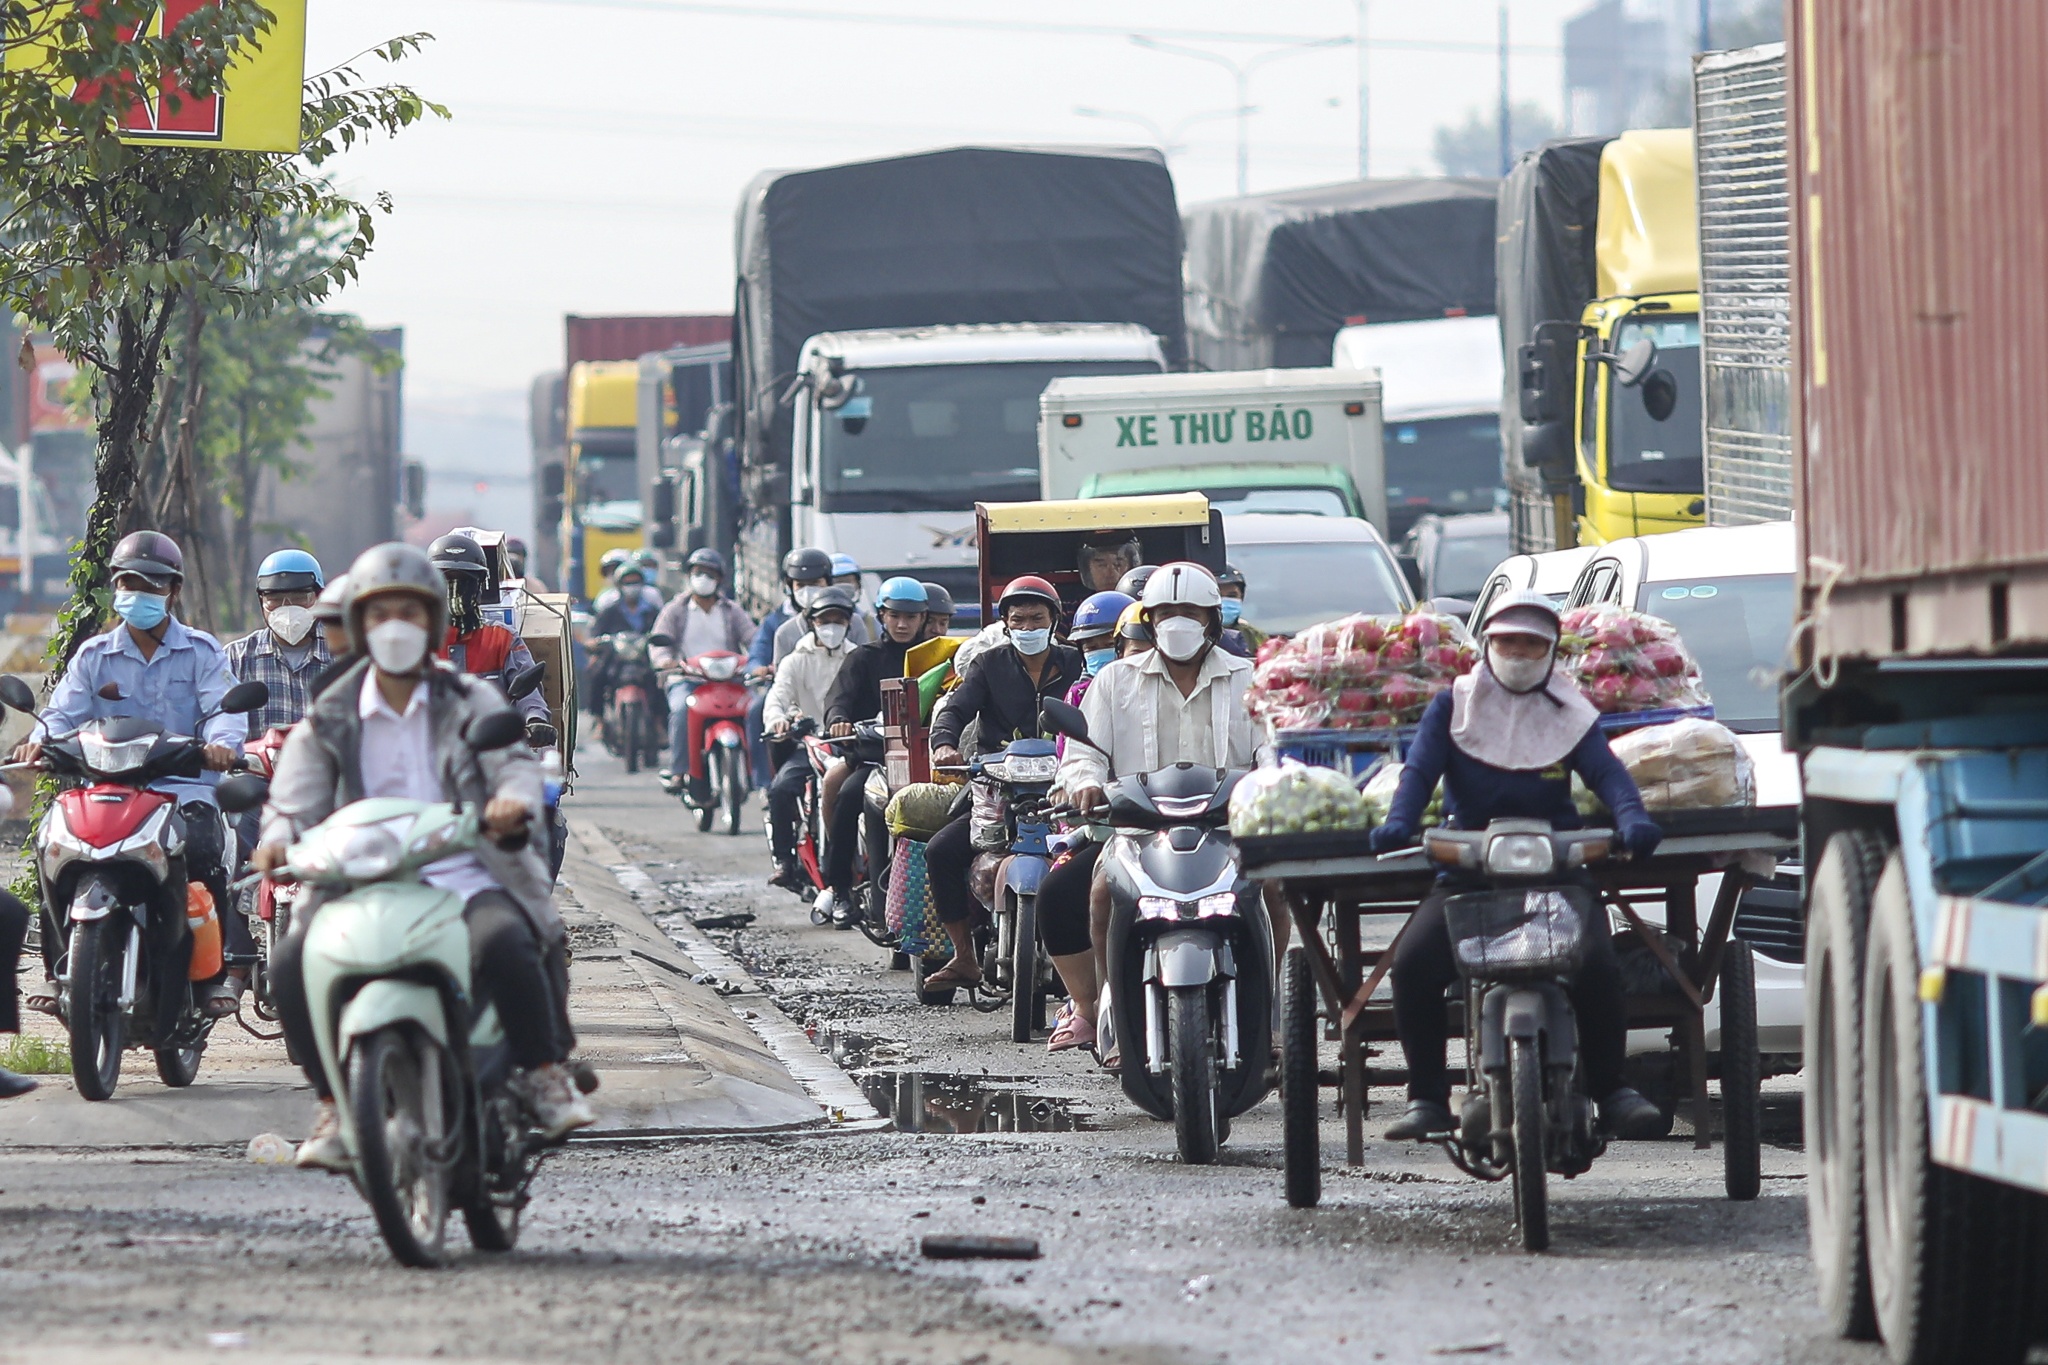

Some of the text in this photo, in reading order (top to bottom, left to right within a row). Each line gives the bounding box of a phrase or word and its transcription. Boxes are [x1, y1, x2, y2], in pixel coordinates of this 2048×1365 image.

[1116, 403, 1313, 447] XE THƯ BÁO
